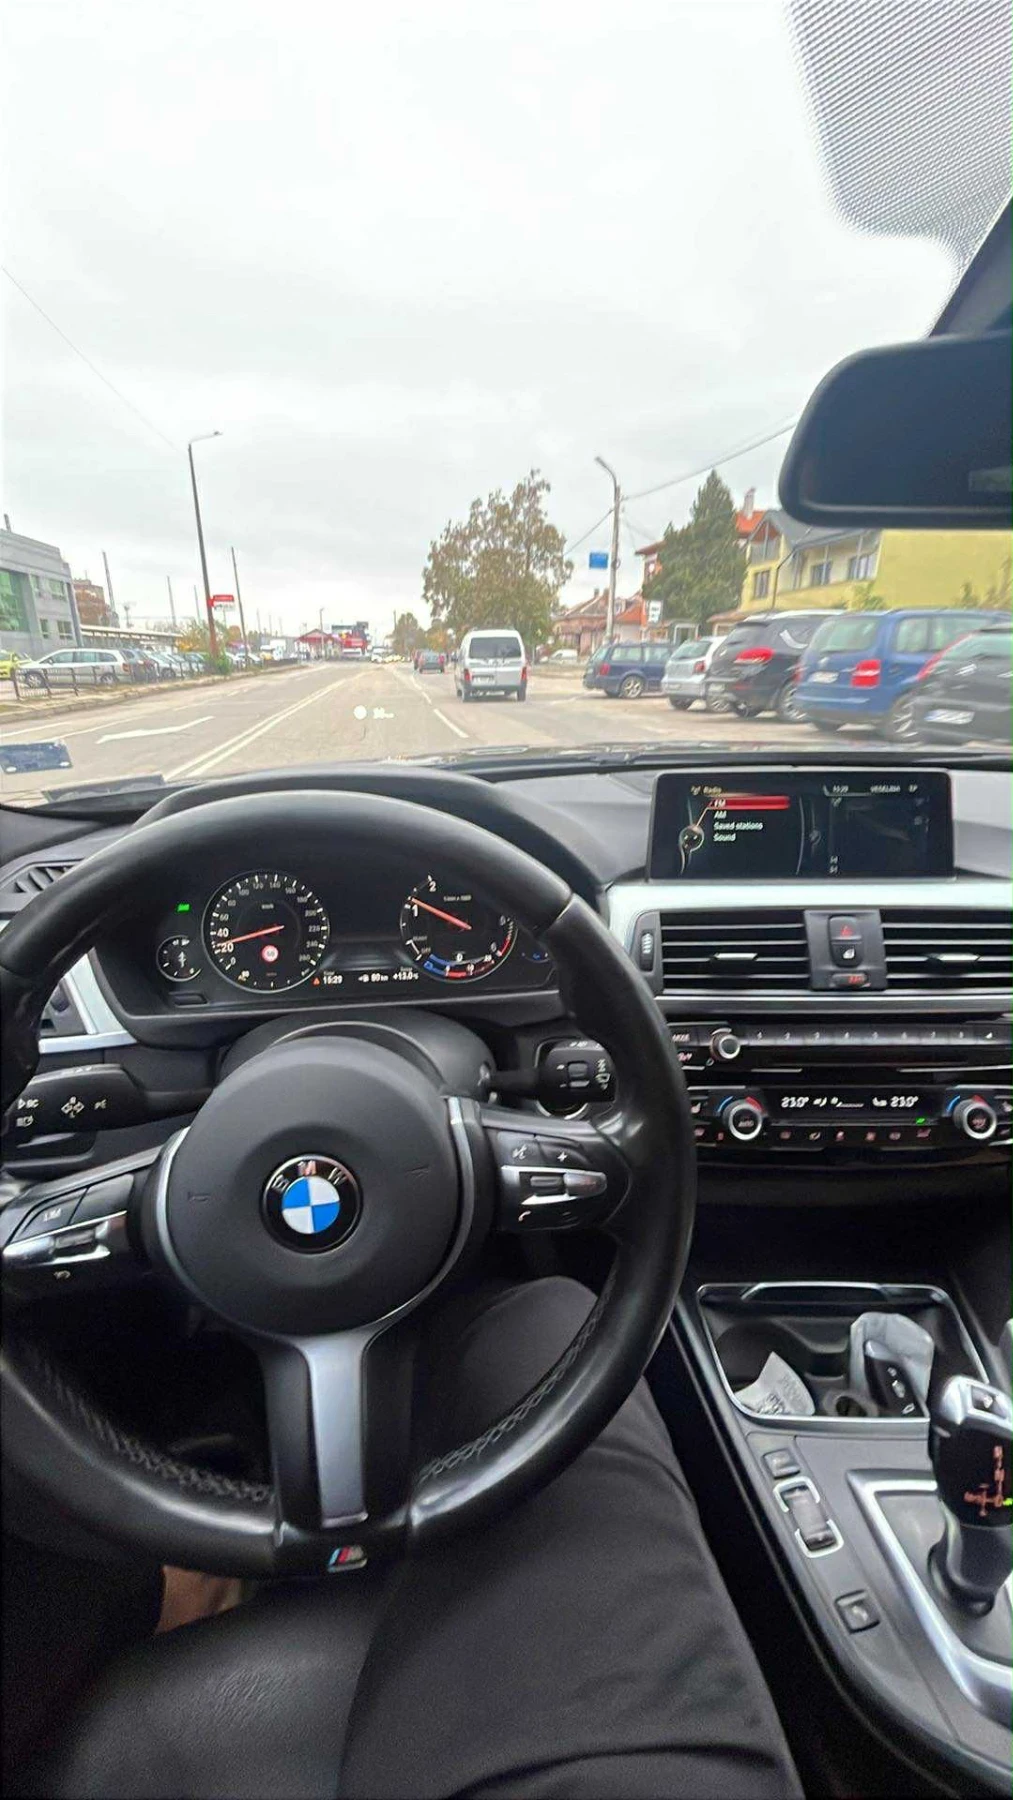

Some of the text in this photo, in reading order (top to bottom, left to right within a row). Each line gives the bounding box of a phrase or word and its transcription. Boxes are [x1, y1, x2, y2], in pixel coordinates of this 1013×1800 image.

[713, 810, 727, 819] AM
[713, 821, 764, 831] Saved stations
[713, 832, 737, 842] Sound
[428, 881, 437, 893] 2
[412, 904, 419, 917] 1
[216, 927, 230, 938] 40
[221, 942, 234, 953] 20
[230, 956, 237, 966] 0
[271, 1160, 349, 1192] BMW
